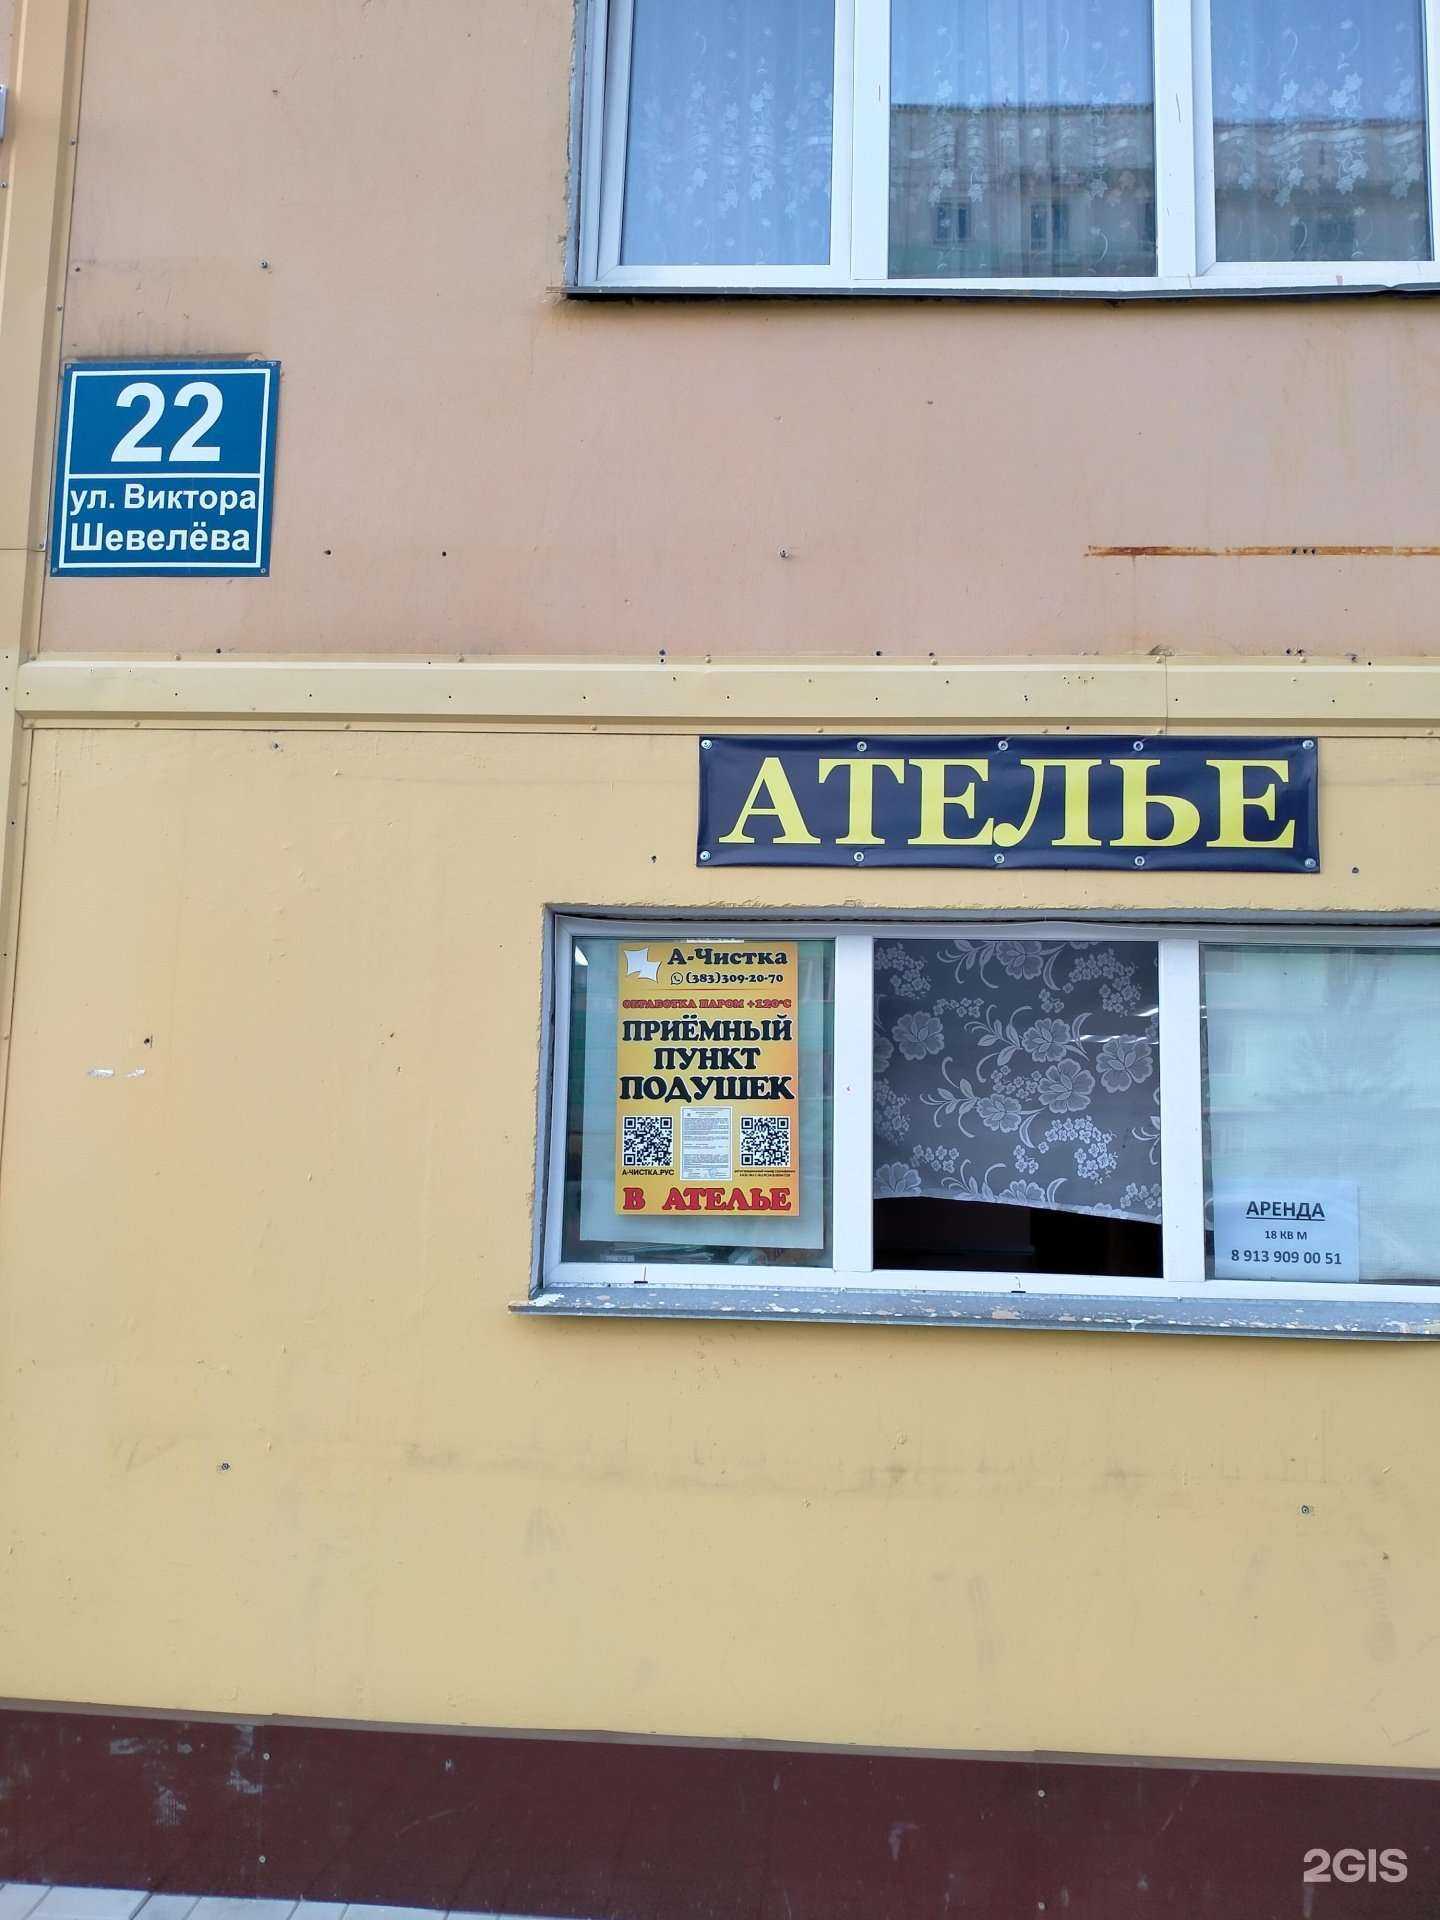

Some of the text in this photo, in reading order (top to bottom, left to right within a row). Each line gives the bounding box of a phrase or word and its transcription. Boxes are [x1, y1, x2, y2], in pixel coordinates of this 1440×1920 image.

[111, 381, 224, 463] 22
[69, 484, 256, 516] ул. Виктора
[70, 521, 250, 551] Шевелёва
[718, 756, 1296, 848] АТЕЛЬЕ
[667, 947, 788, 966] А-Чистка
[686, 972, 783, 984] (383)309-20-70
[622, 998, 697, 1009] ОБРАБОТКА
[699, 998, 744, 1009] ПАРОМ
[622, 1014, 793, 1041] ПРИЁМНЫЙ
[654, 1048, 761, 1070] ПУНКТ
[619, 1076, 795, 1103] ПОДУШЕК
[623, 1187, 791, 1210] В АТЕЛЬЕ
[1246, 1201, 1325, 1220] АРЕНДА
[1264, 1230, 1277, 1239] 18
[1231, 1249, 1342, 1265] 8 913 909 00 51
